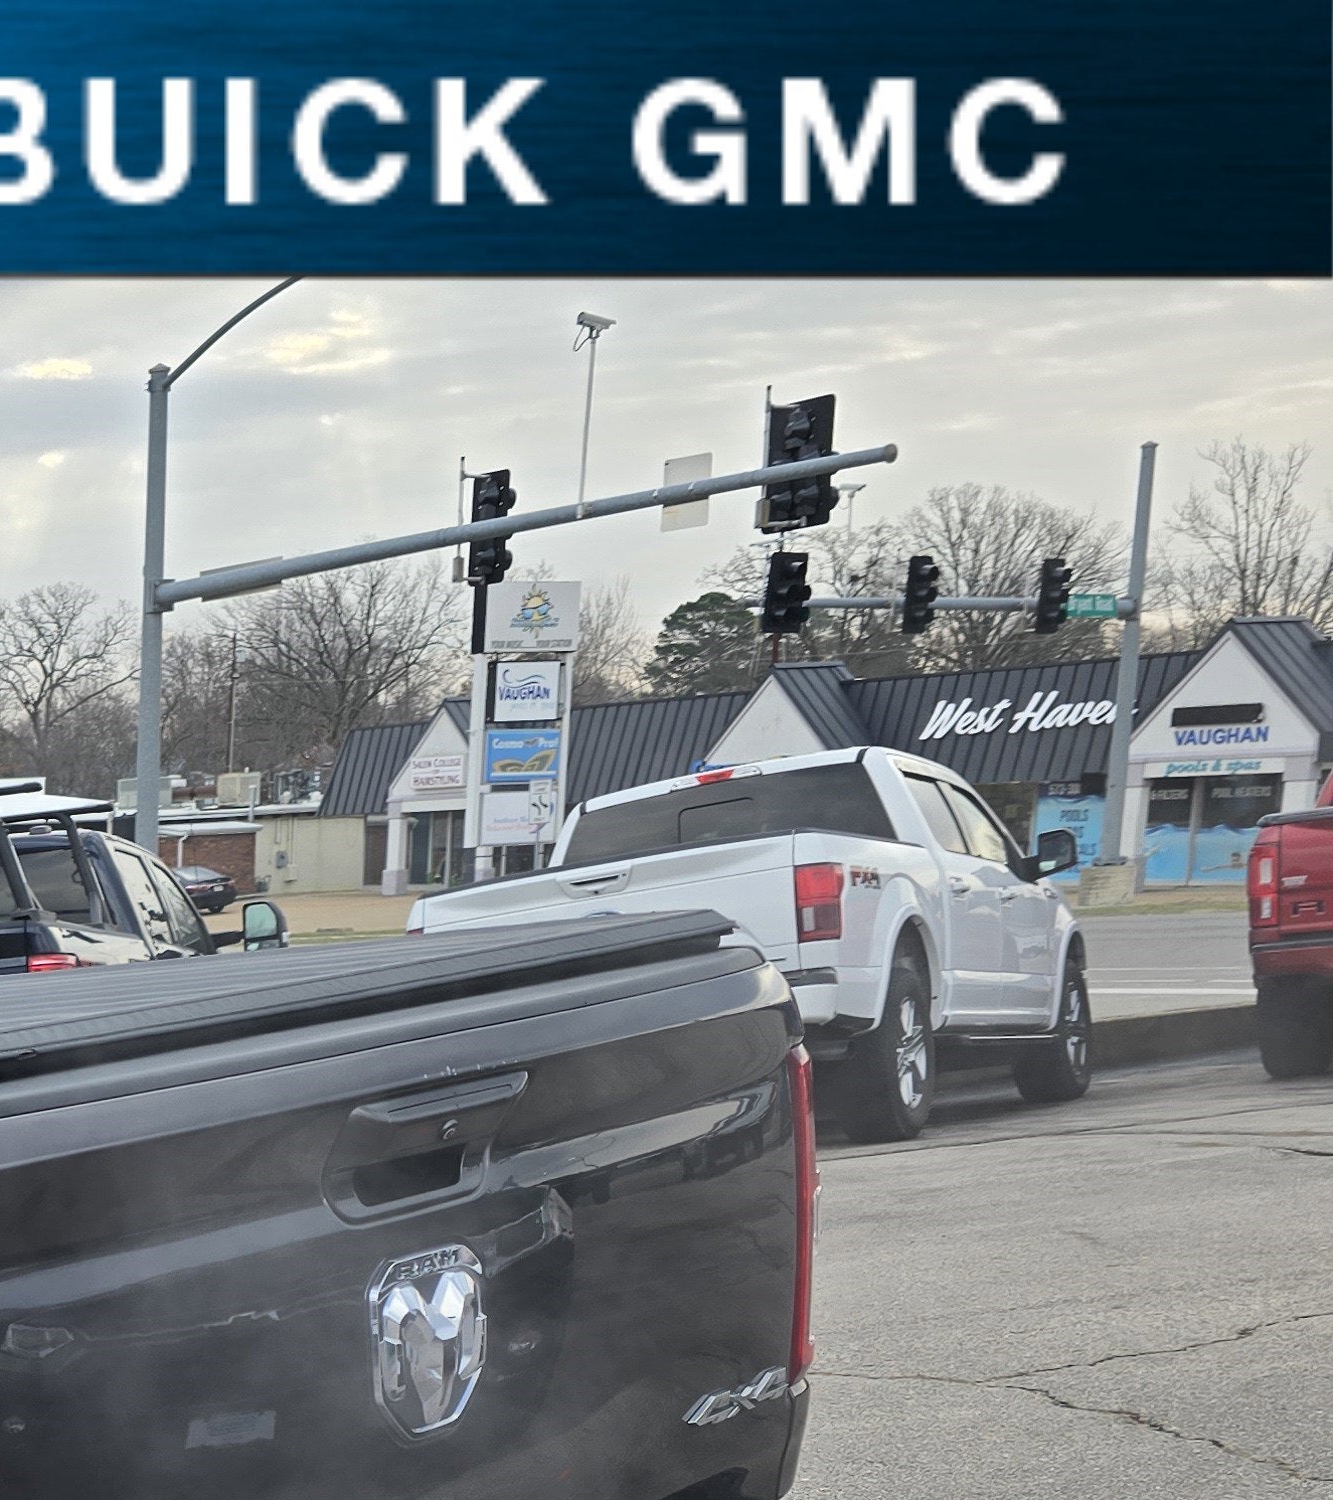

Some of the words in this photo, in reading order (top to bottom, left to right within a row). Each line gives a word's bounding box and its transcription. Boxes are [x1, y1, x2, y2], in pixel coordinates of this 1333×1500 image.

[499, 686, 551, 701] VAUGHAN
[919, 697, 1013, 740] West
[1174, 726, 1270, 746] VAUGHAN
[1164, 760, 1209, 778] pools
[1225, 759, 1262, 775] spas
[1059, 808, 1090, 823] POOLS
[396, 1247, 462, 1281] RAM
